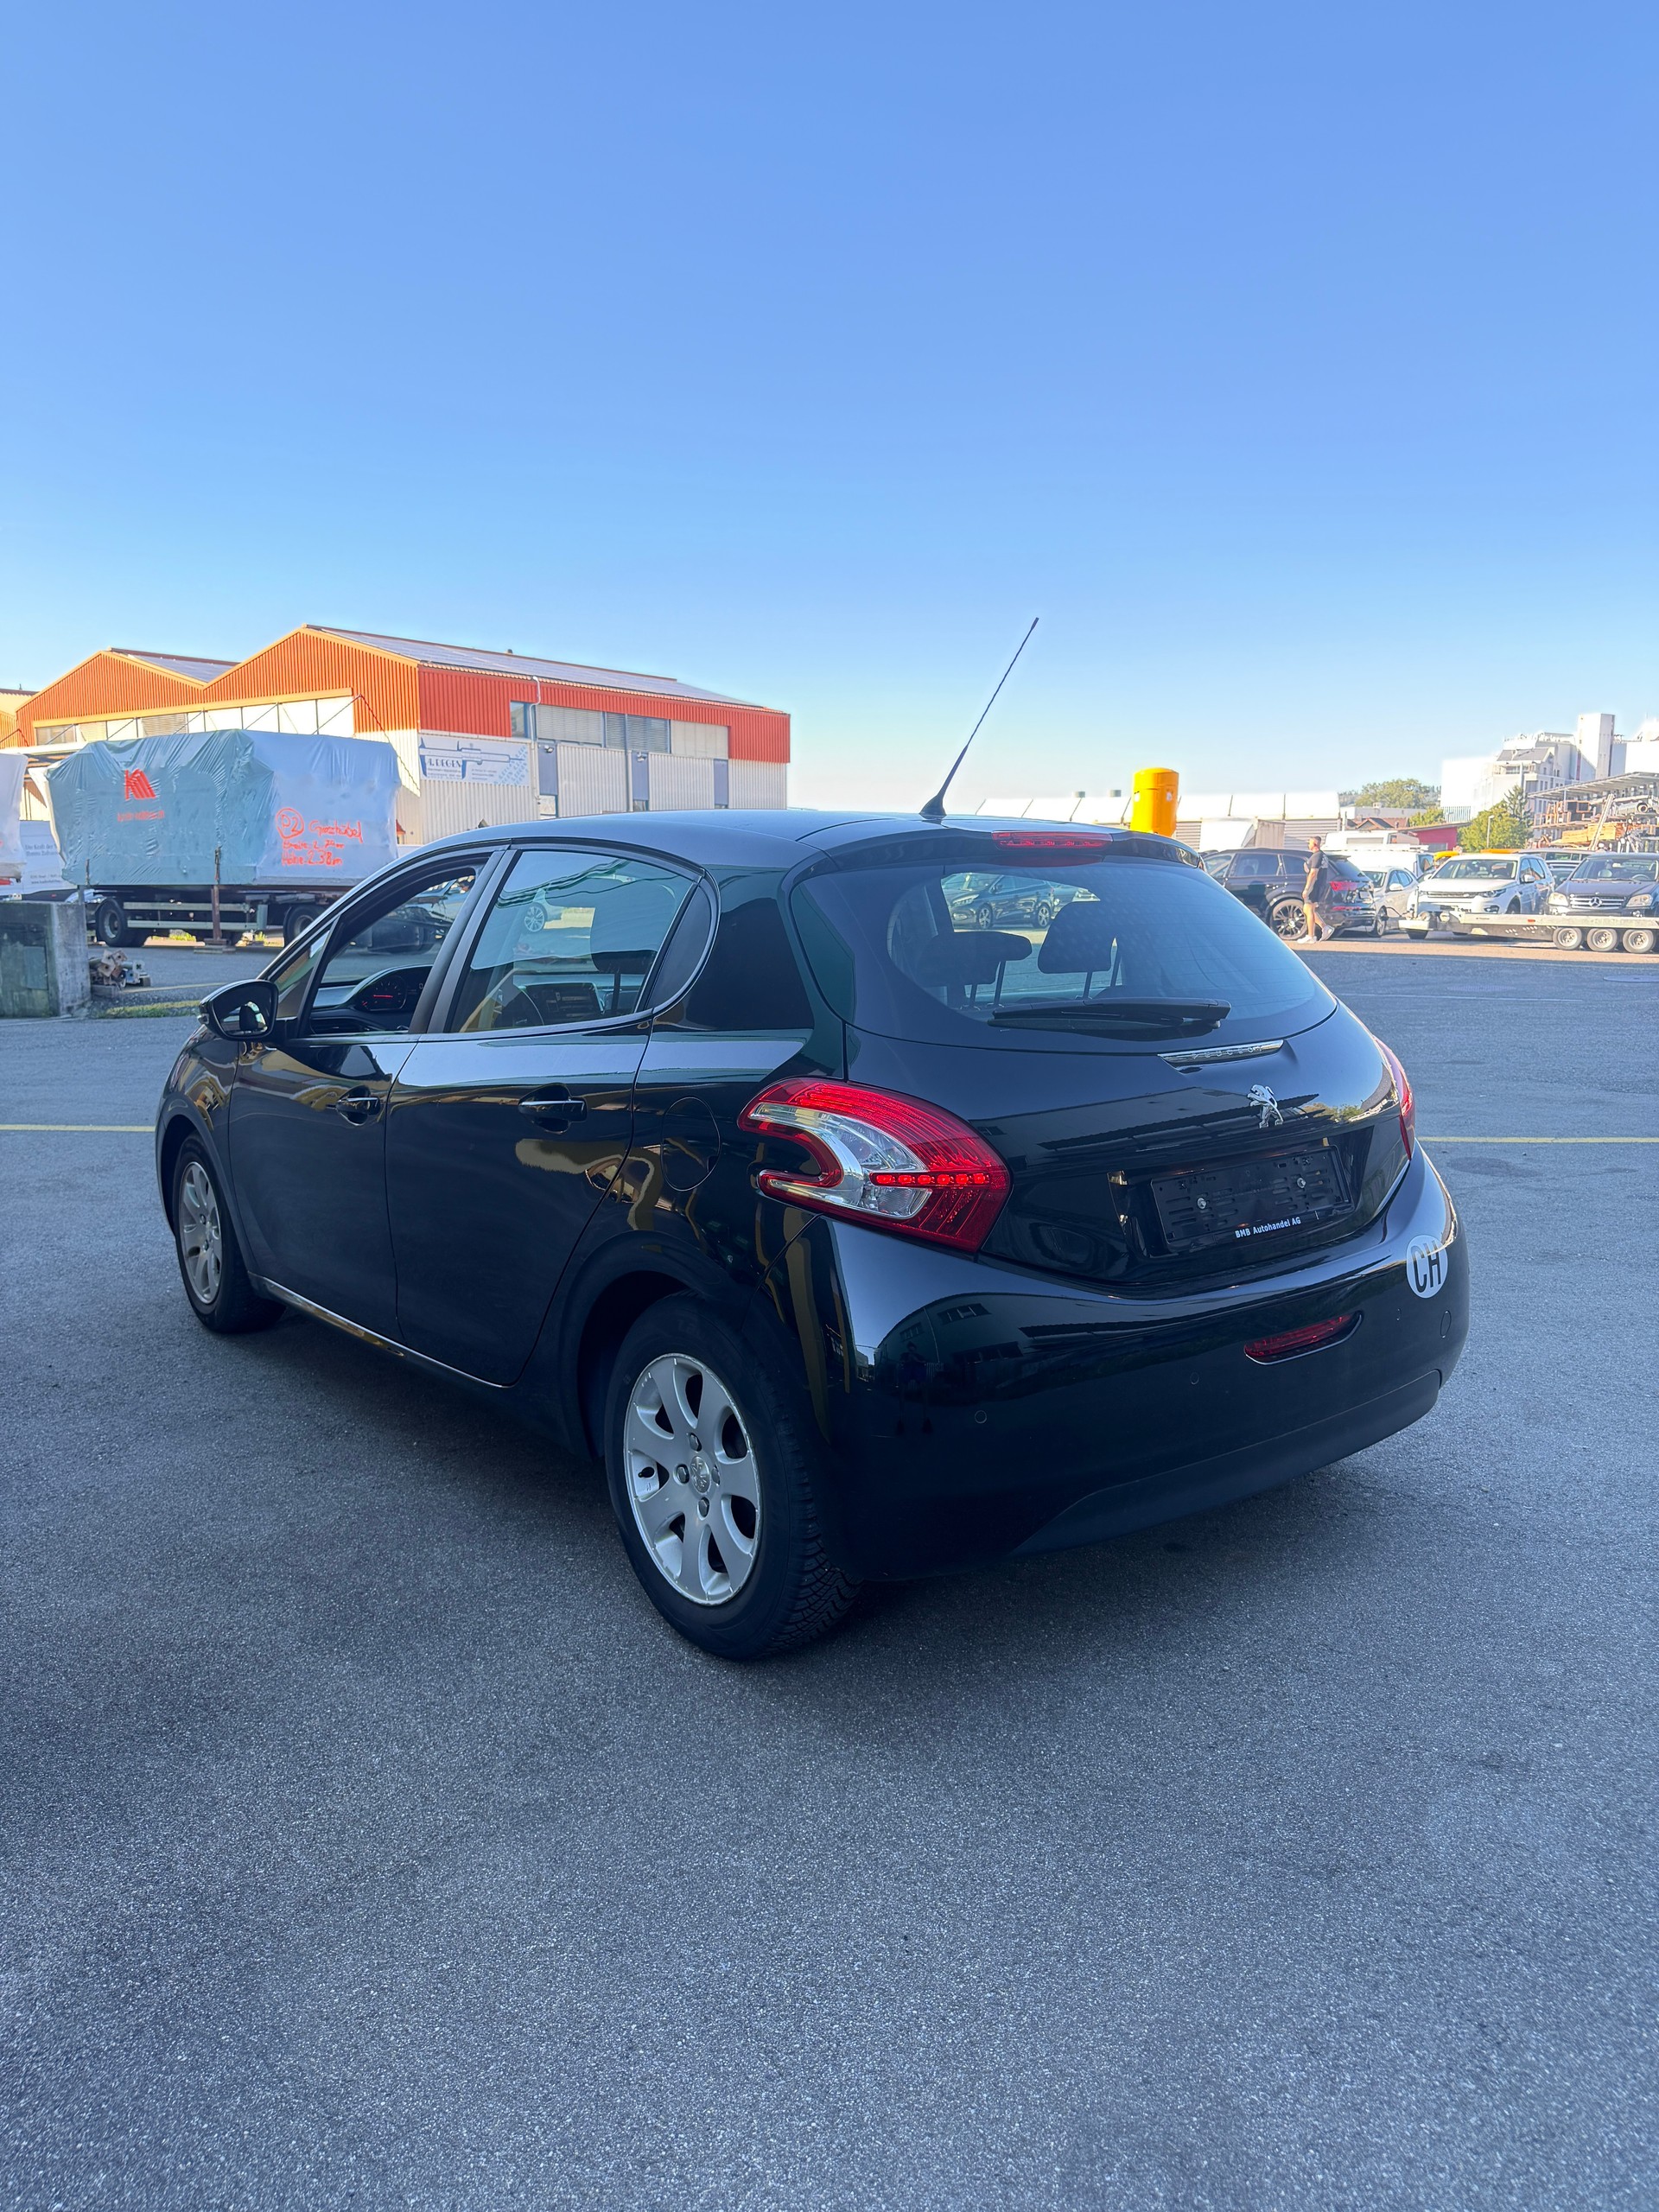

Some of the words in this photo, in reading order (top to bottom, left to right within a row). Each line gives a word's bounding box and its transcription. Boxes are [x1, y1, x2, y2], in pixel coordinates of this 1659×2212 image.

[1235, 1228, 1251, 1238] BMB
[1253, 1218, 1291, 1235] Autohandel
[1291, 1217, 1301, 1226] AG
[1410, 1240, 1441, 1294] CH
